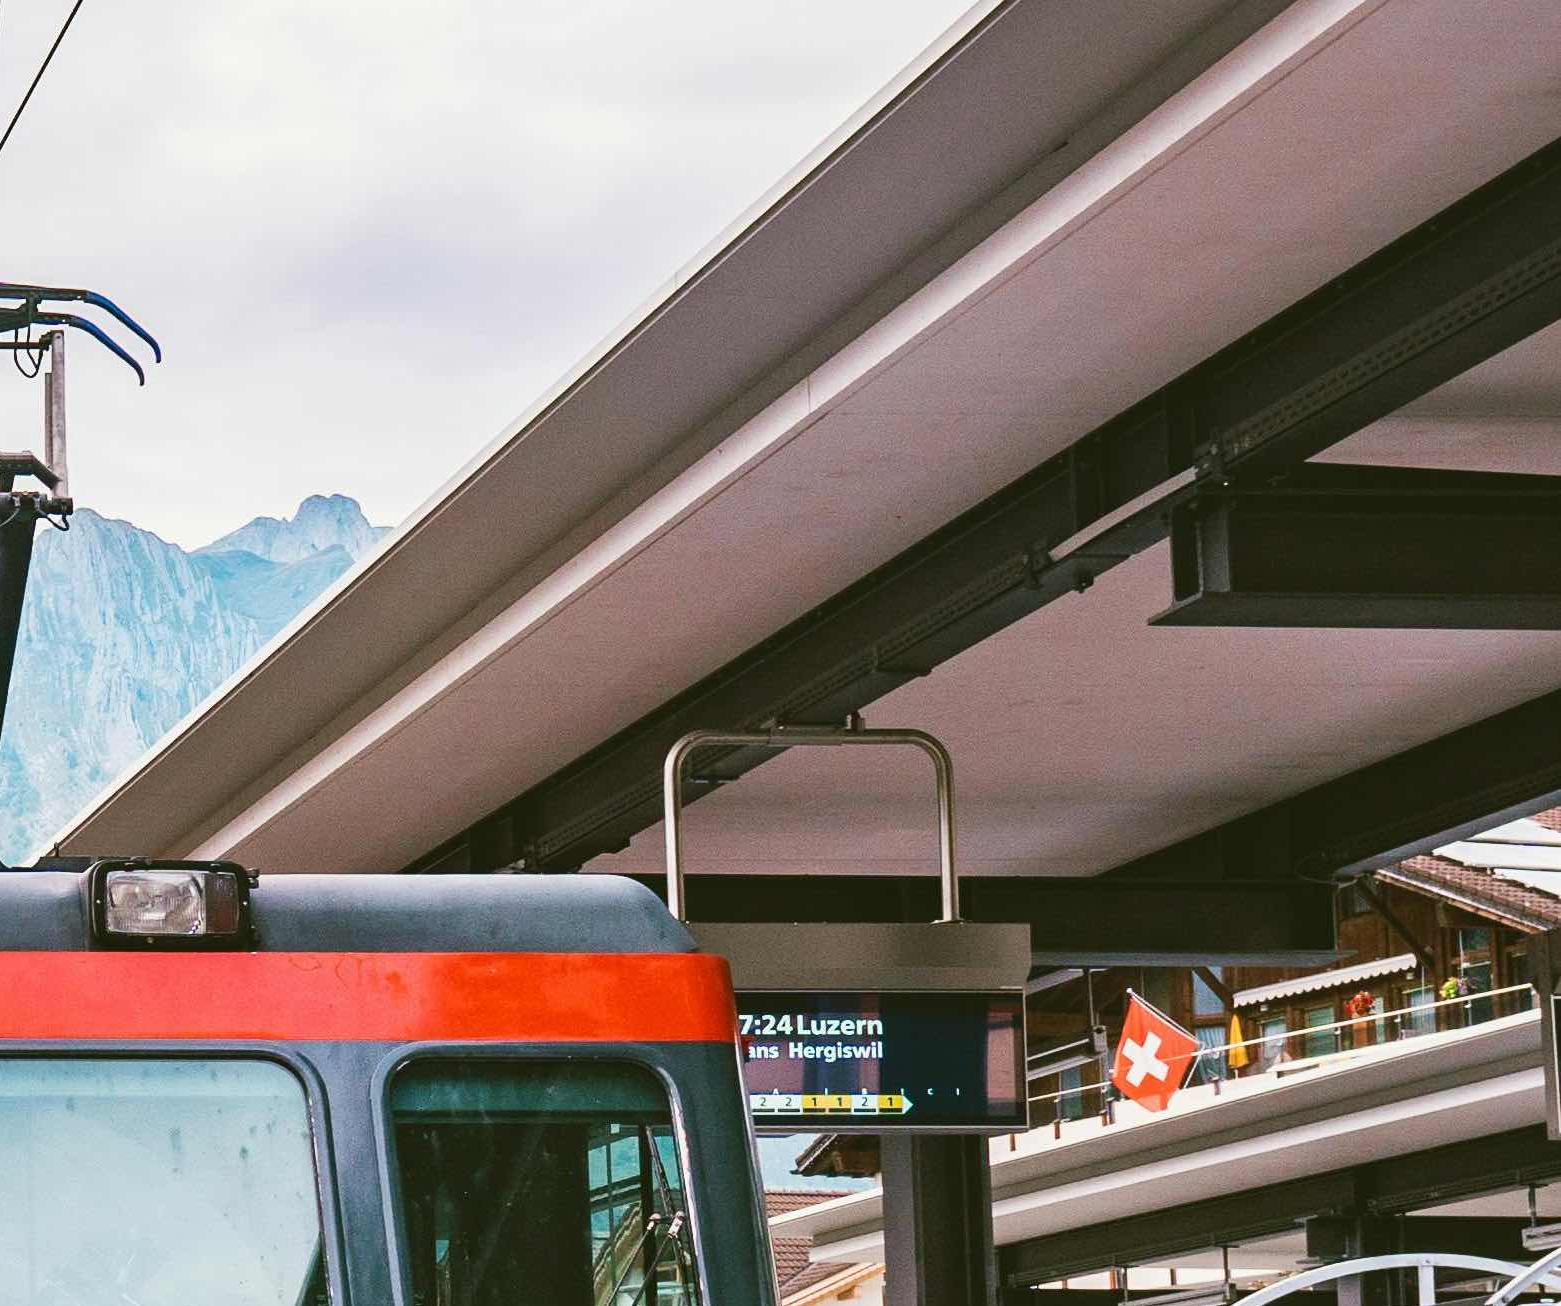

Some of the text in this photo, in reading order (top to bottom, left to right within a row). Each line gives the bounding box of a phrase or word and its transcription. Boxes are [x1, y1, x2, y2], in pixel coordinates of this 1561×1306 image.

[796, 1014, 884, 1035] Luzern
[788, 1041, 884, 1062] Hergiswil
[759, 1097, 767, 1107] 2
[784, 1097, 792, 1107] 2
[861, 1096, 869, 1107] 2
